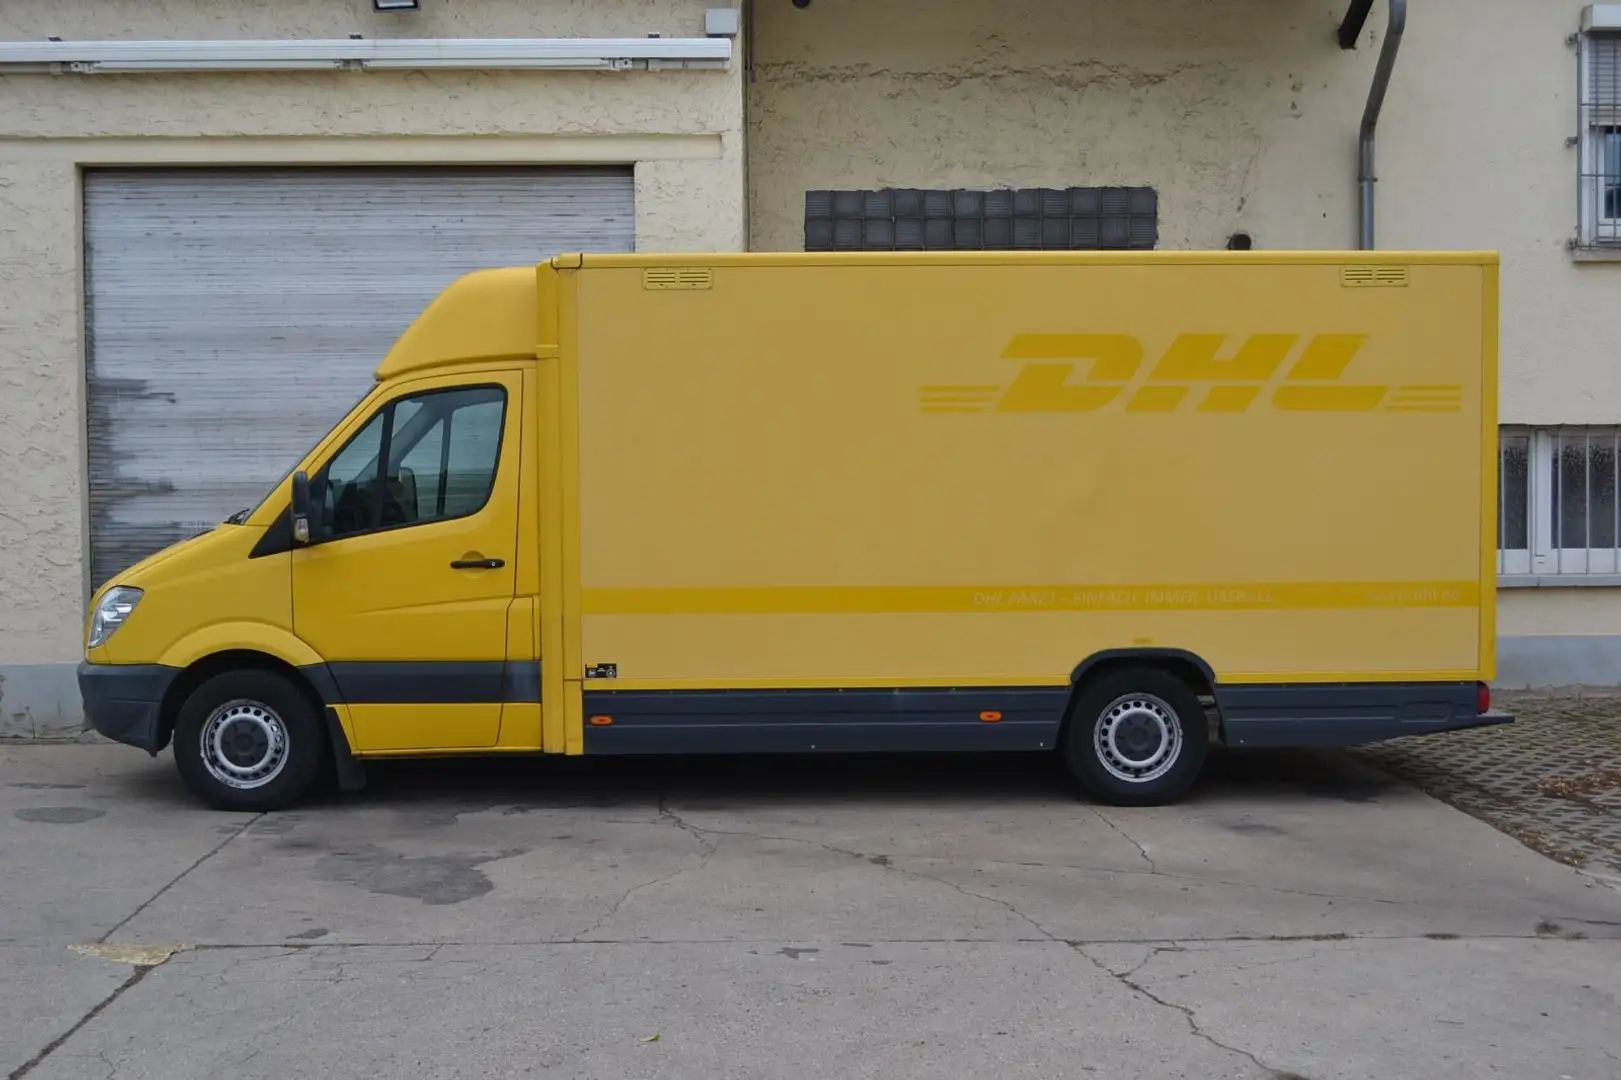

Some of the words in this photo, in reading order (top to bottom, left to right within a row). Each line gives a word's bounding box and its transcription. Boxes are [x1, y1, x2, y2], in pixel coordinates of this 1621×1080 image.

[998, 333, 1389, 412] DHL
[973, 590, 1005, 606] DHL
[1072, 589, 1137, 605] EINFACH
[1366, 587, 1460, 602] .dhl.de
